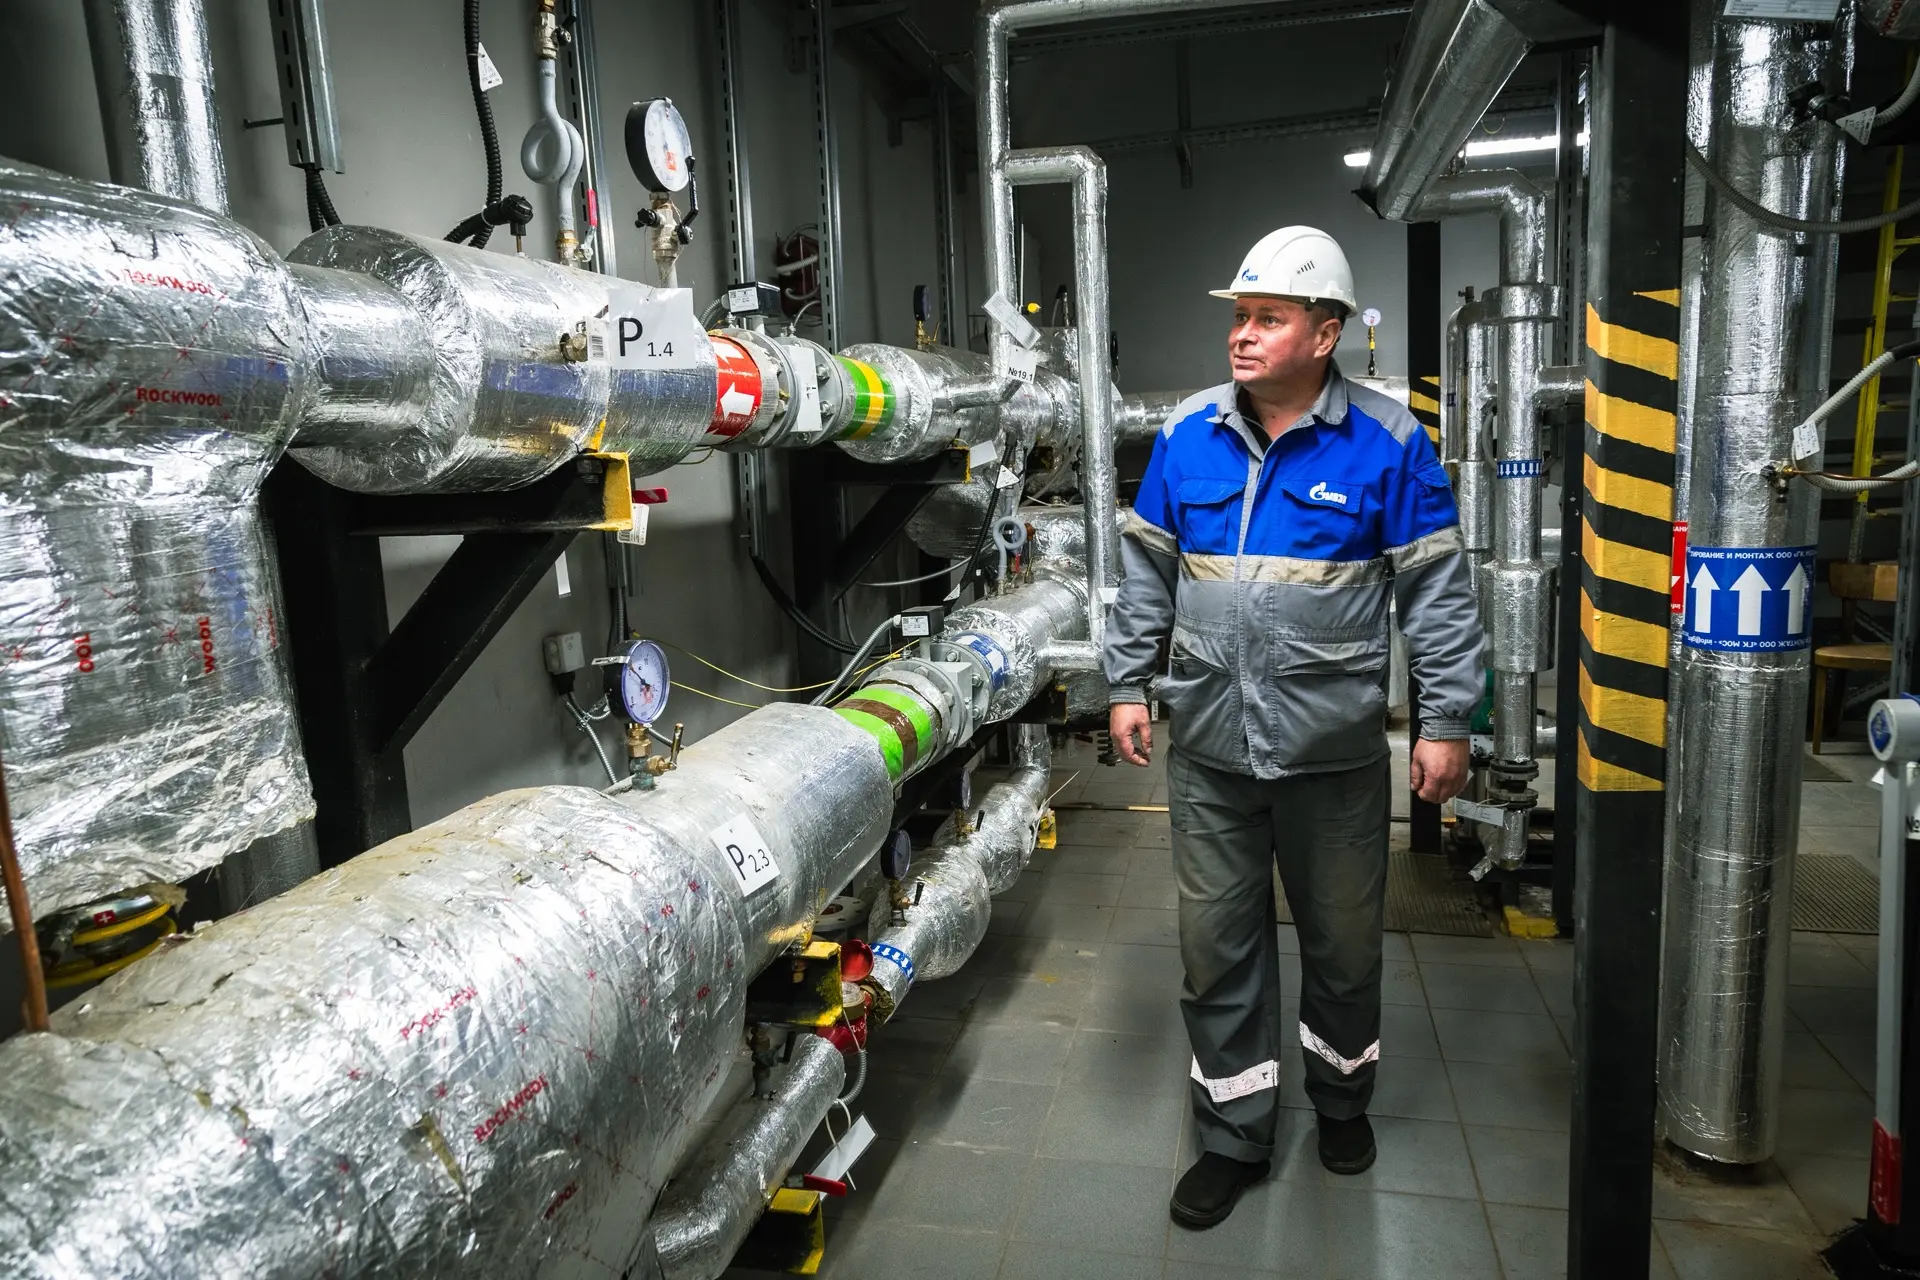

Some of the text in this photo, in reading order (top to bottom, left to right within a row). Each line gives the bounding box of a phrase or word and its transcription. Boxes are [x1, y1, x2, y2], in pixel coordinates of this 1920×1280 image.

[647, 341, 674, 357] 1.4
[1007, 366, 1034, 382] №19.1
[136, 387, 223, 407] ROCKWOOL
[748, 848, 770, 873] 2.3
[473, 1072, 550, 1145] ROCKWOOL
